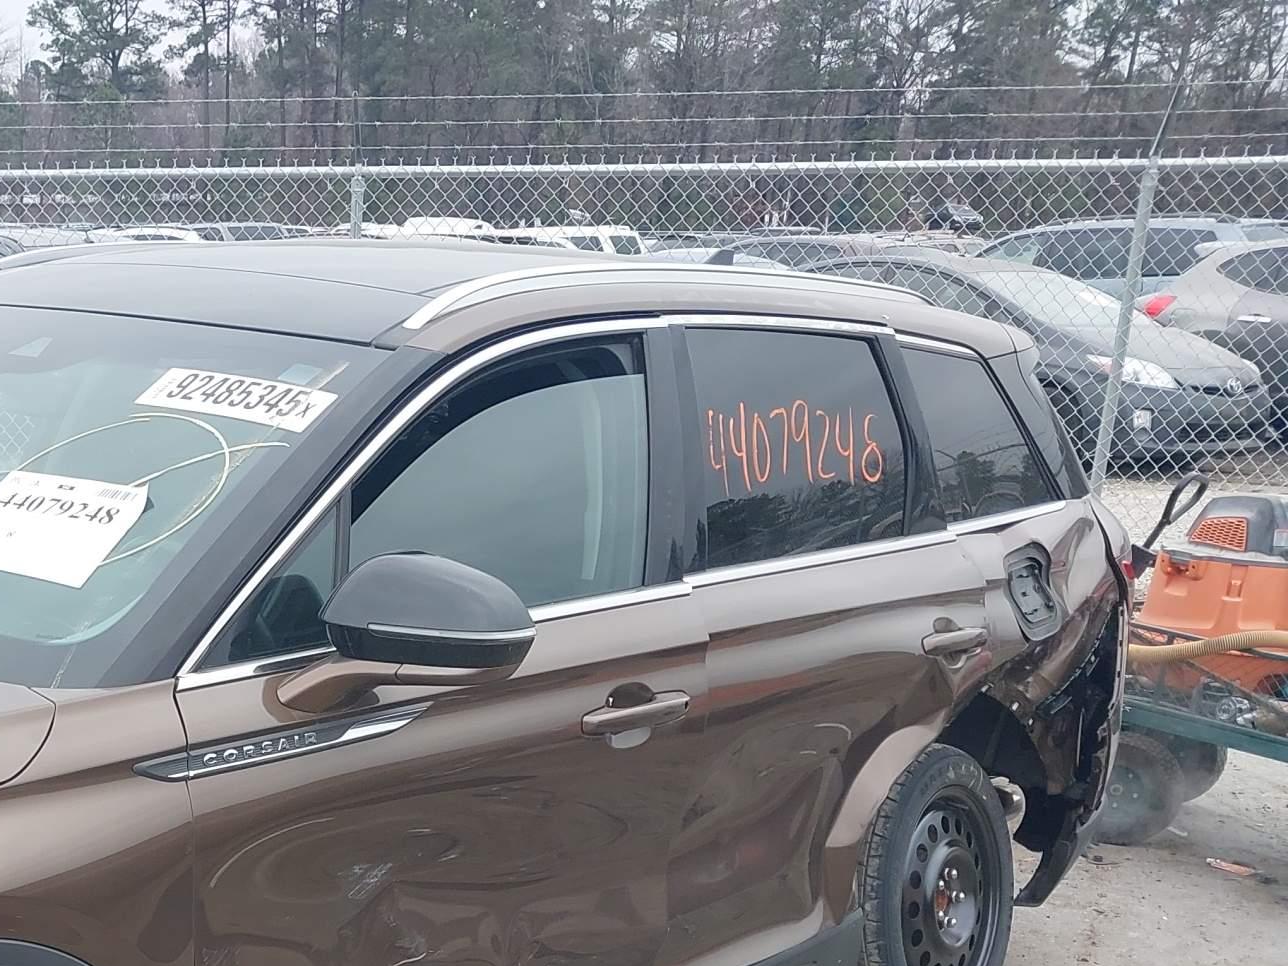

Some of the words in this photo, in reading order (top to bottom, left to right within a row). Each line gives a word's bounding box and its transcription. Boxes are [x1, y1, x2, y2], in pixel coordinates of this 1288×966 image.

[166, 372, 314, 417] 92485345
[707, 399, 884, 498] 44079248
[0, 492, 121, 525] 44079248
[202, 731, 318, 767] CORSAIR
